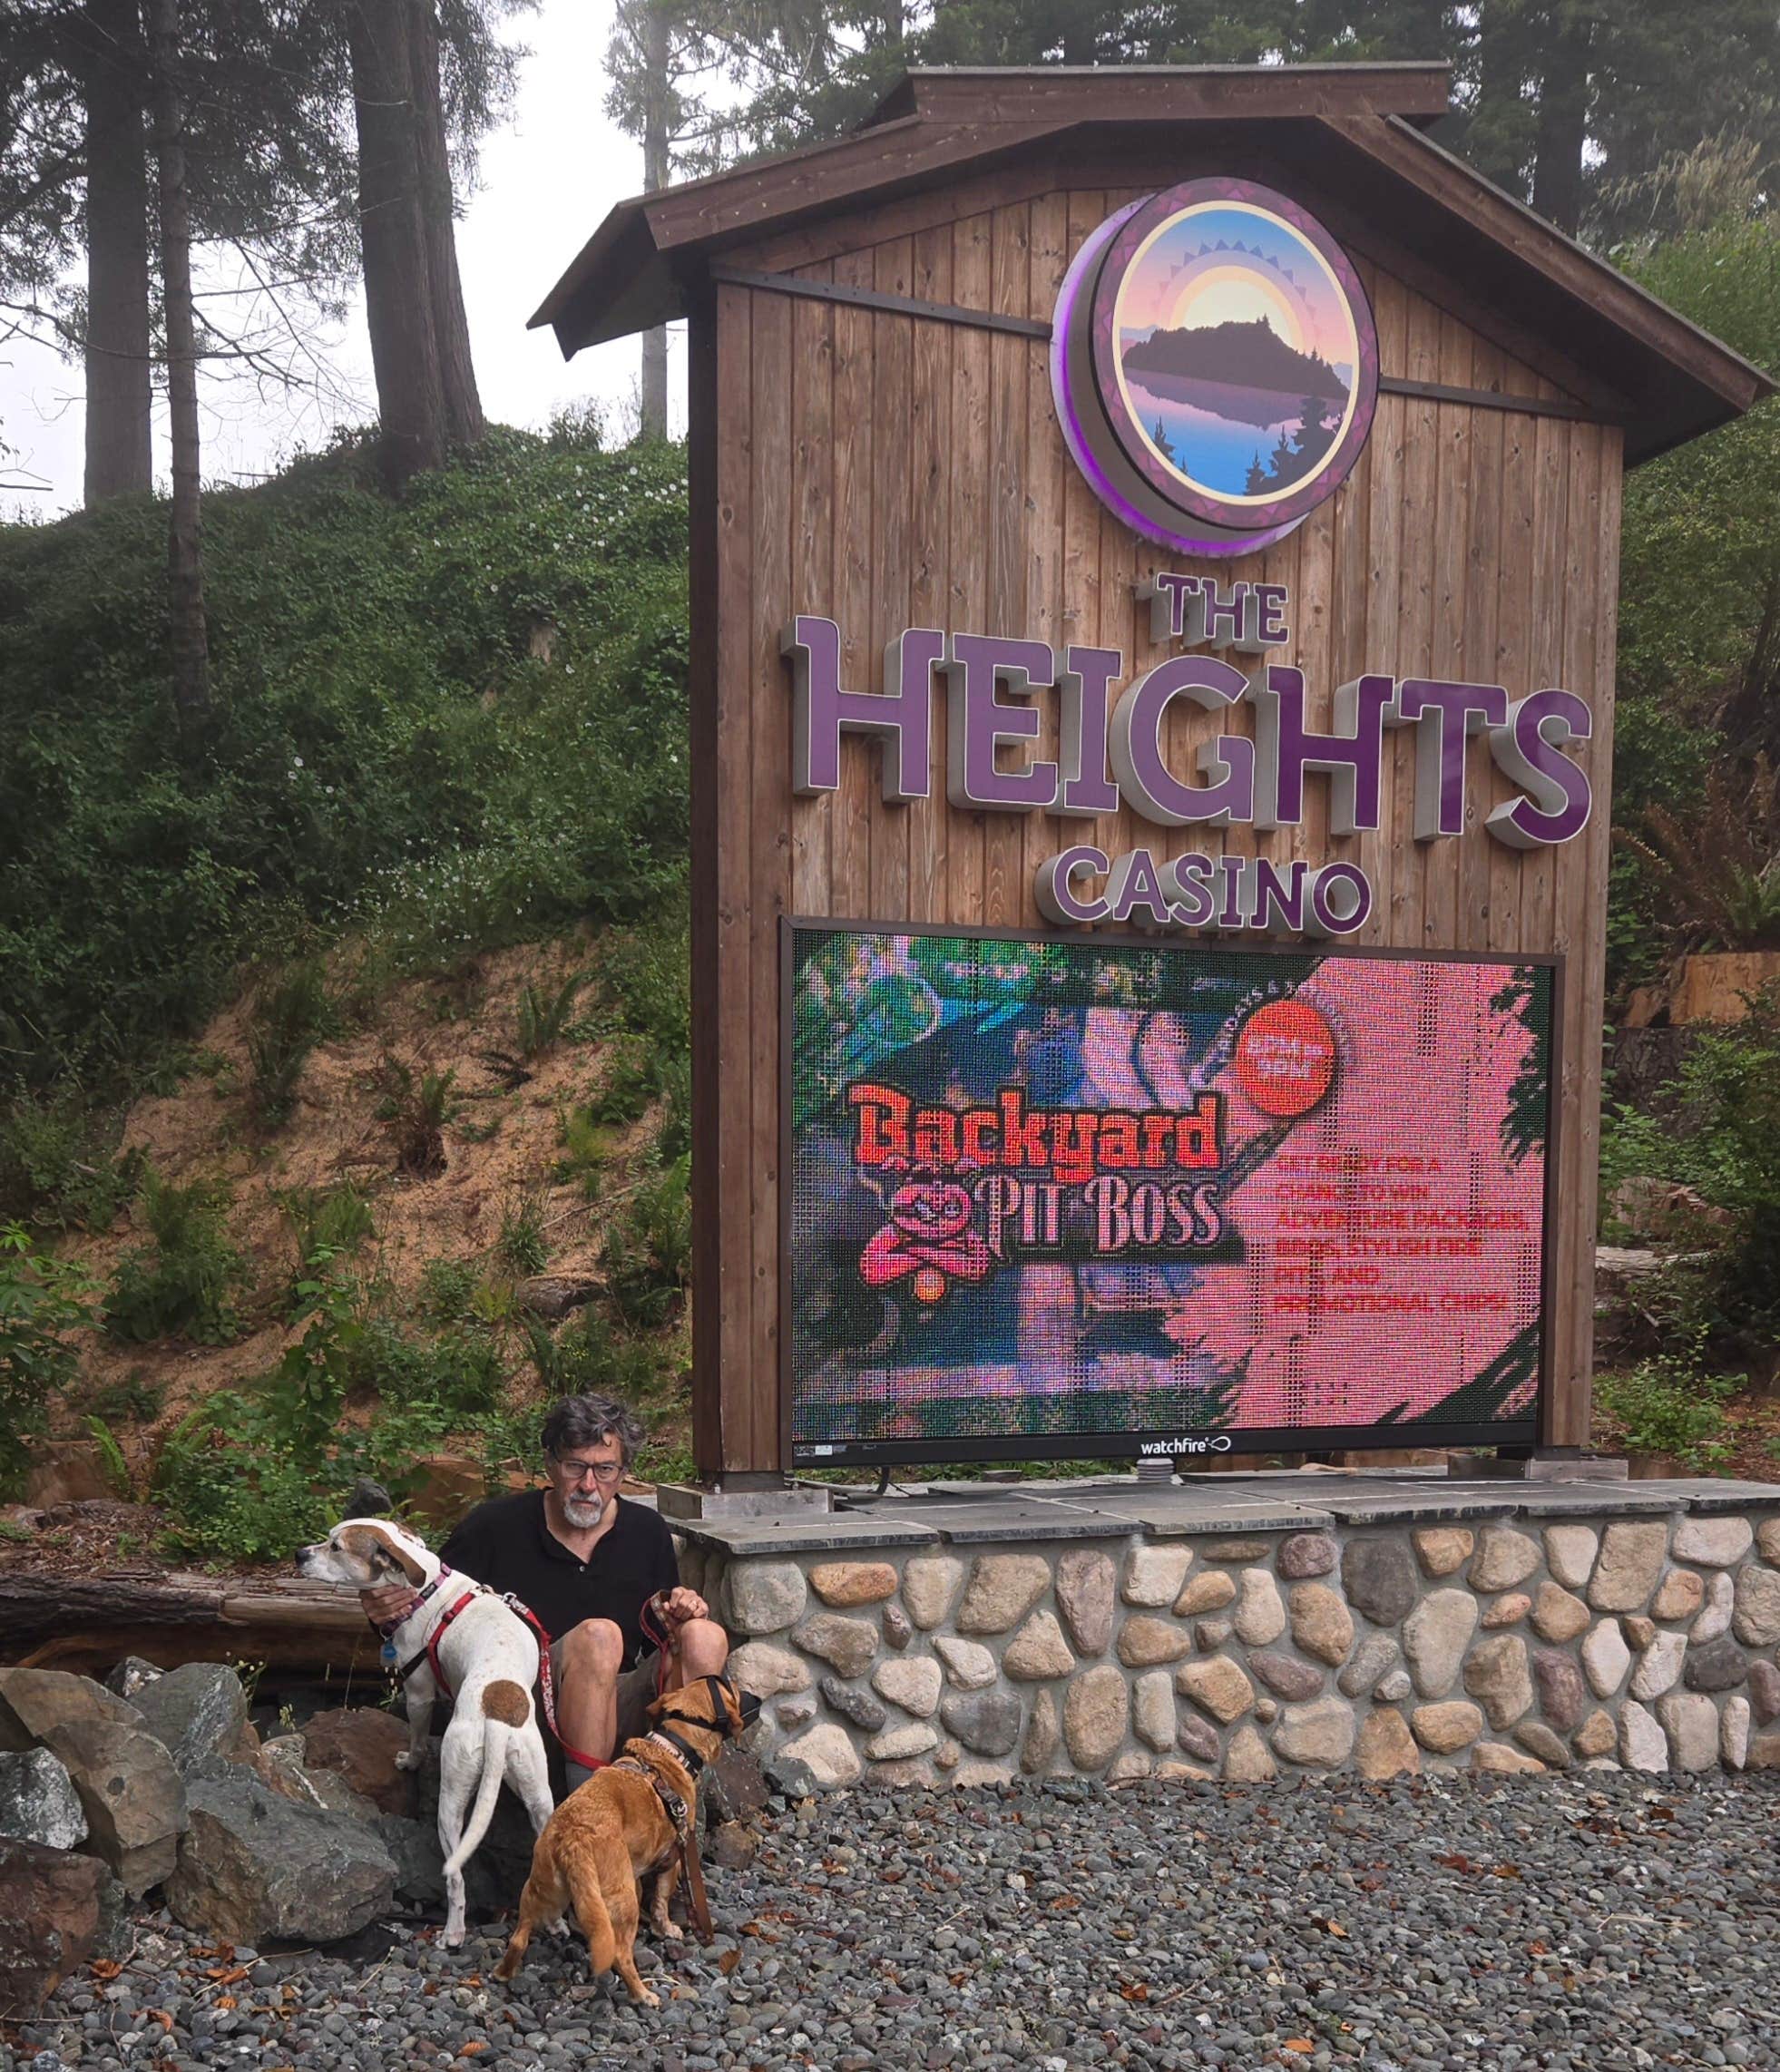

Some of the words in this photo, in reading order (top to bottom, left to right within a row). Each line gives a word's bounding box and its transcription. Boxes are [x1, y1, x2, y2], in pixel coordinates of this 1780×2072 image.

[1154, 572, 1290, 646] THE
[792, 614, 1594, 846] HEIGHTS
[1048, 845, 1374, 936] CASINO
[847, 1083, 1223, 1183] Backyard
[975, 1175, 1071, 1262] PIT
[1084, 1176, 1222, 1258] BOSS
[1140, 1437, 1208, 1455] watchfire
